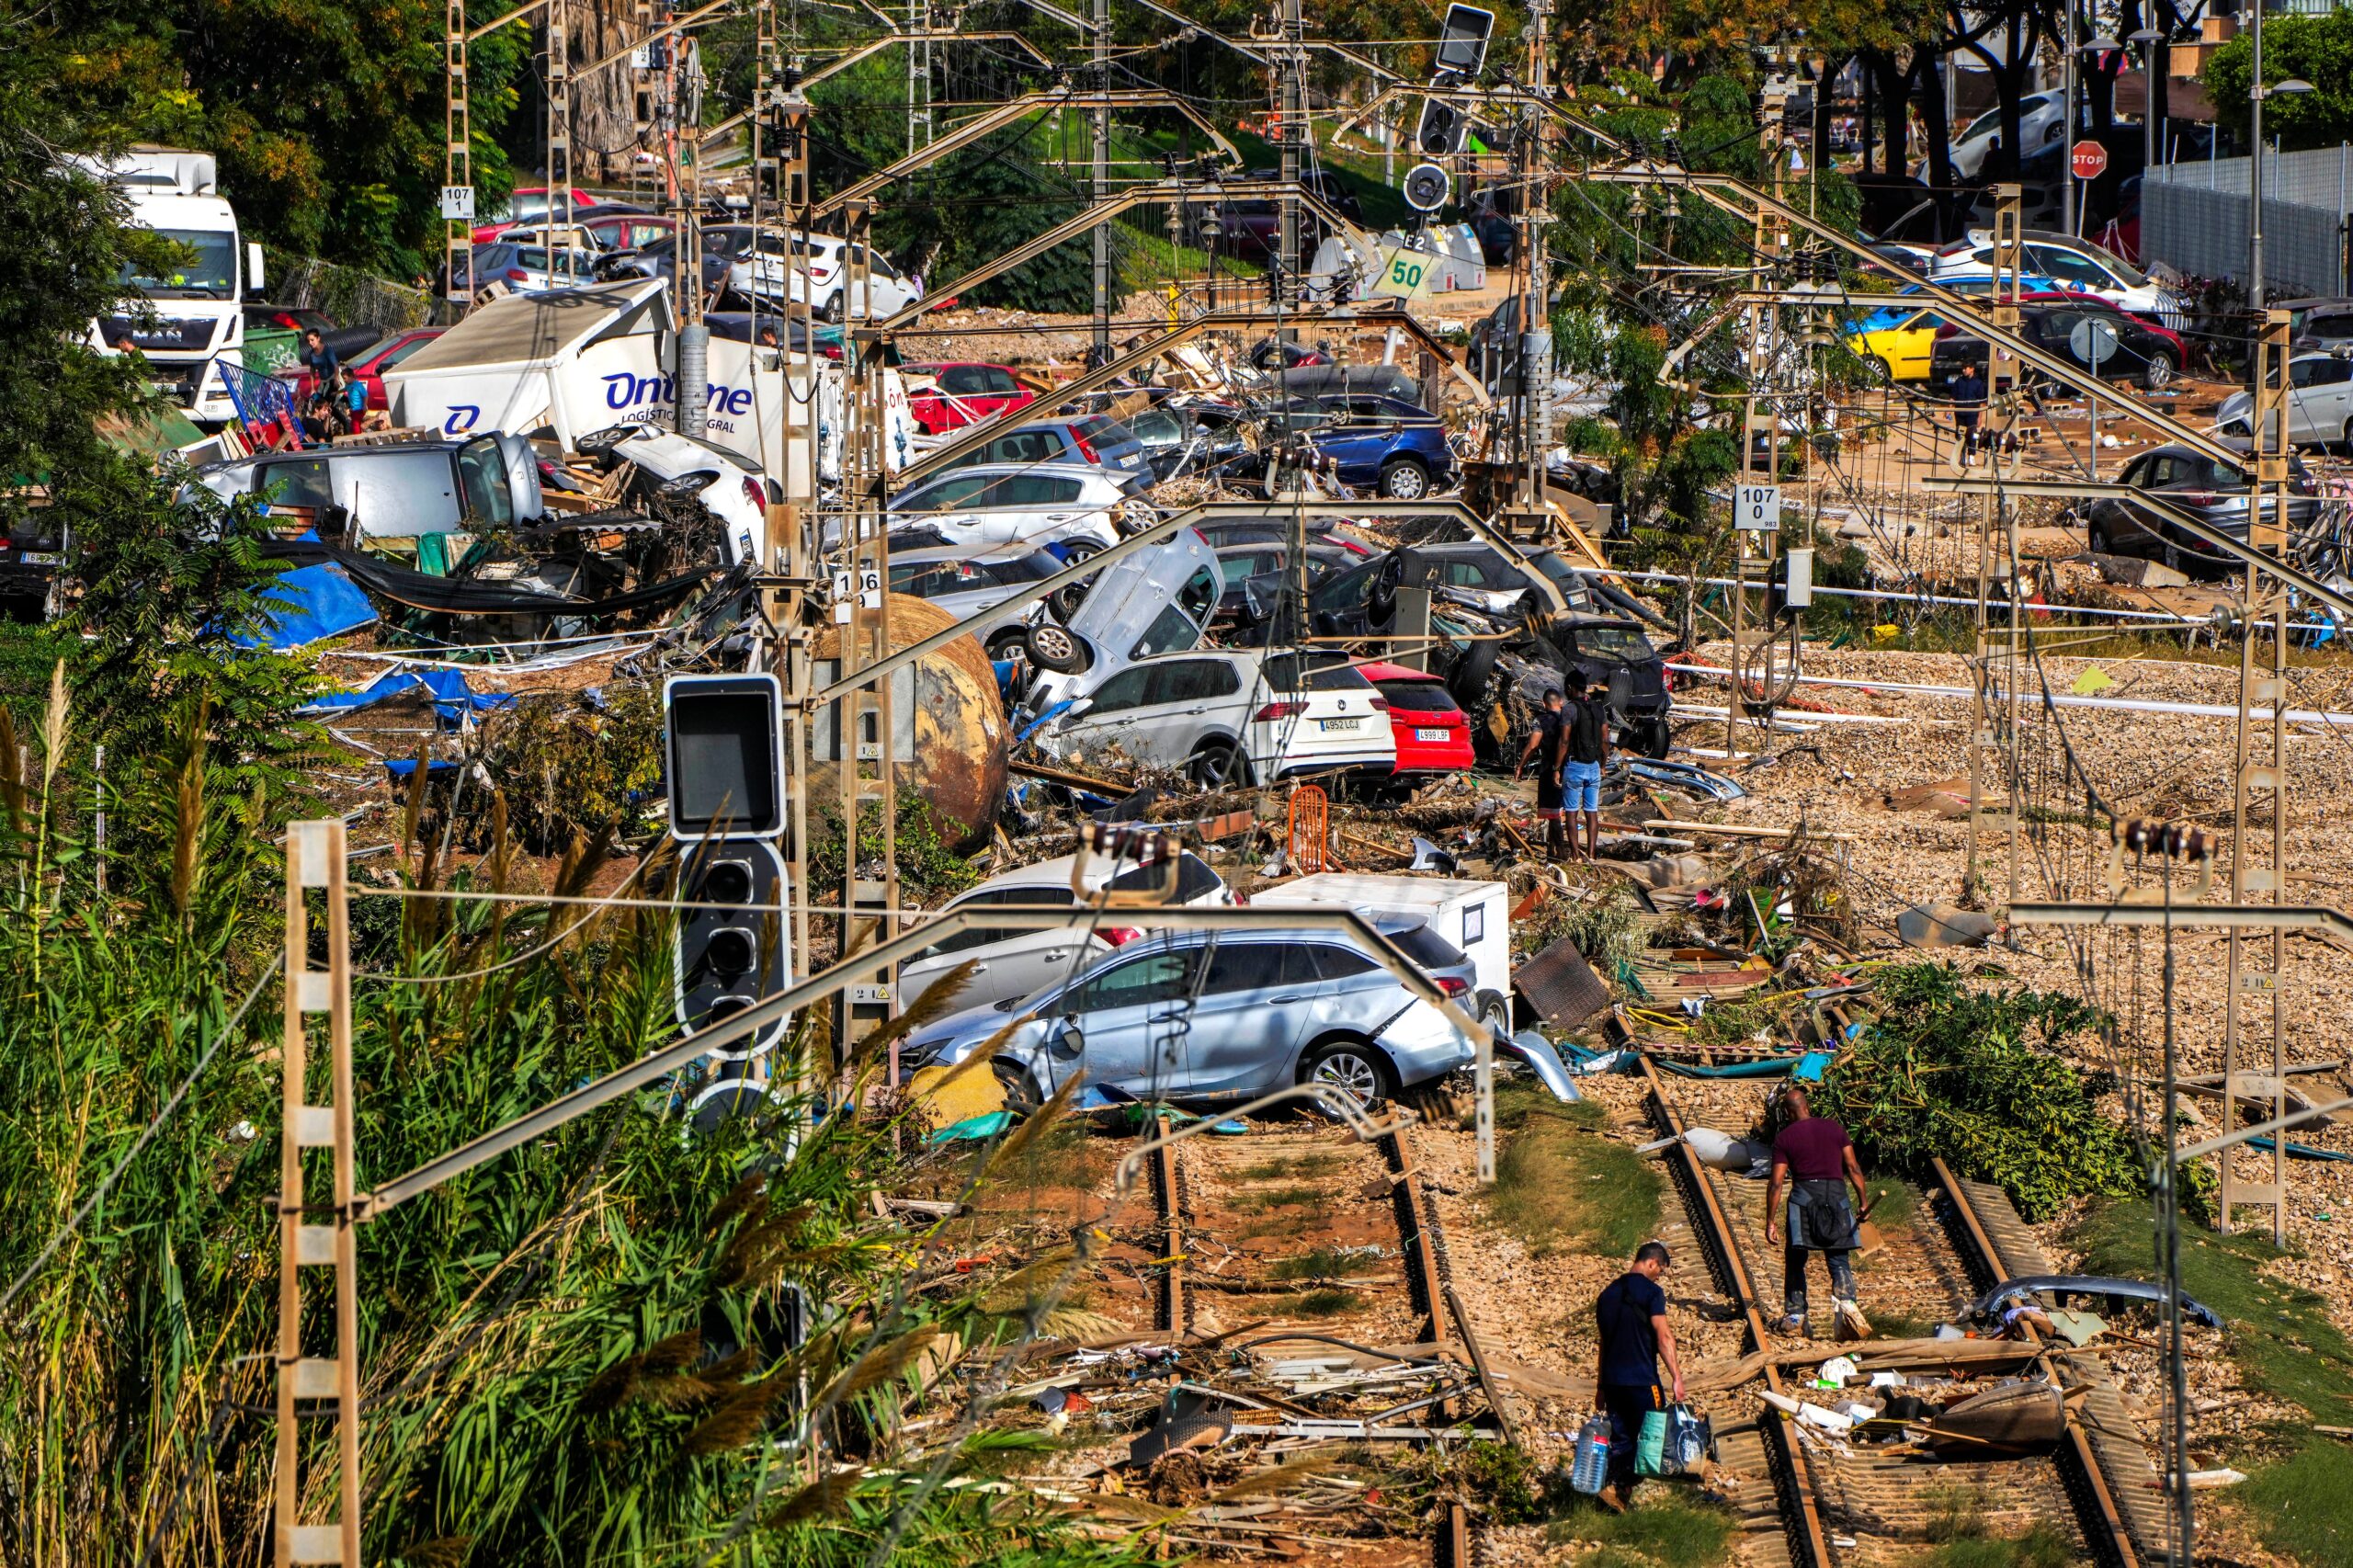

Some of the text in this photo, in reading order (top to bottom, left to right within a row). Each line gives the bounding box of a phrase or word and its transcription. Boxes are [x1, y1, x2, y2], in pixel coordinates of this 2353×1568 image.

[2073, 154, 2104, 165] STOP
[446, 188, 469, 199] 107
[455, 200, 461, 211] 1
[1404, 234, 1426, 251] E 2
[1392, 260, 1422, 288] 50
[1742, 488, 1775, 504] 107
[1753, 505, 1763, 519] 0
[1325, 718, 1359, 731] 4952 LCJ
[1420, 730, 1437, 740] 4999
